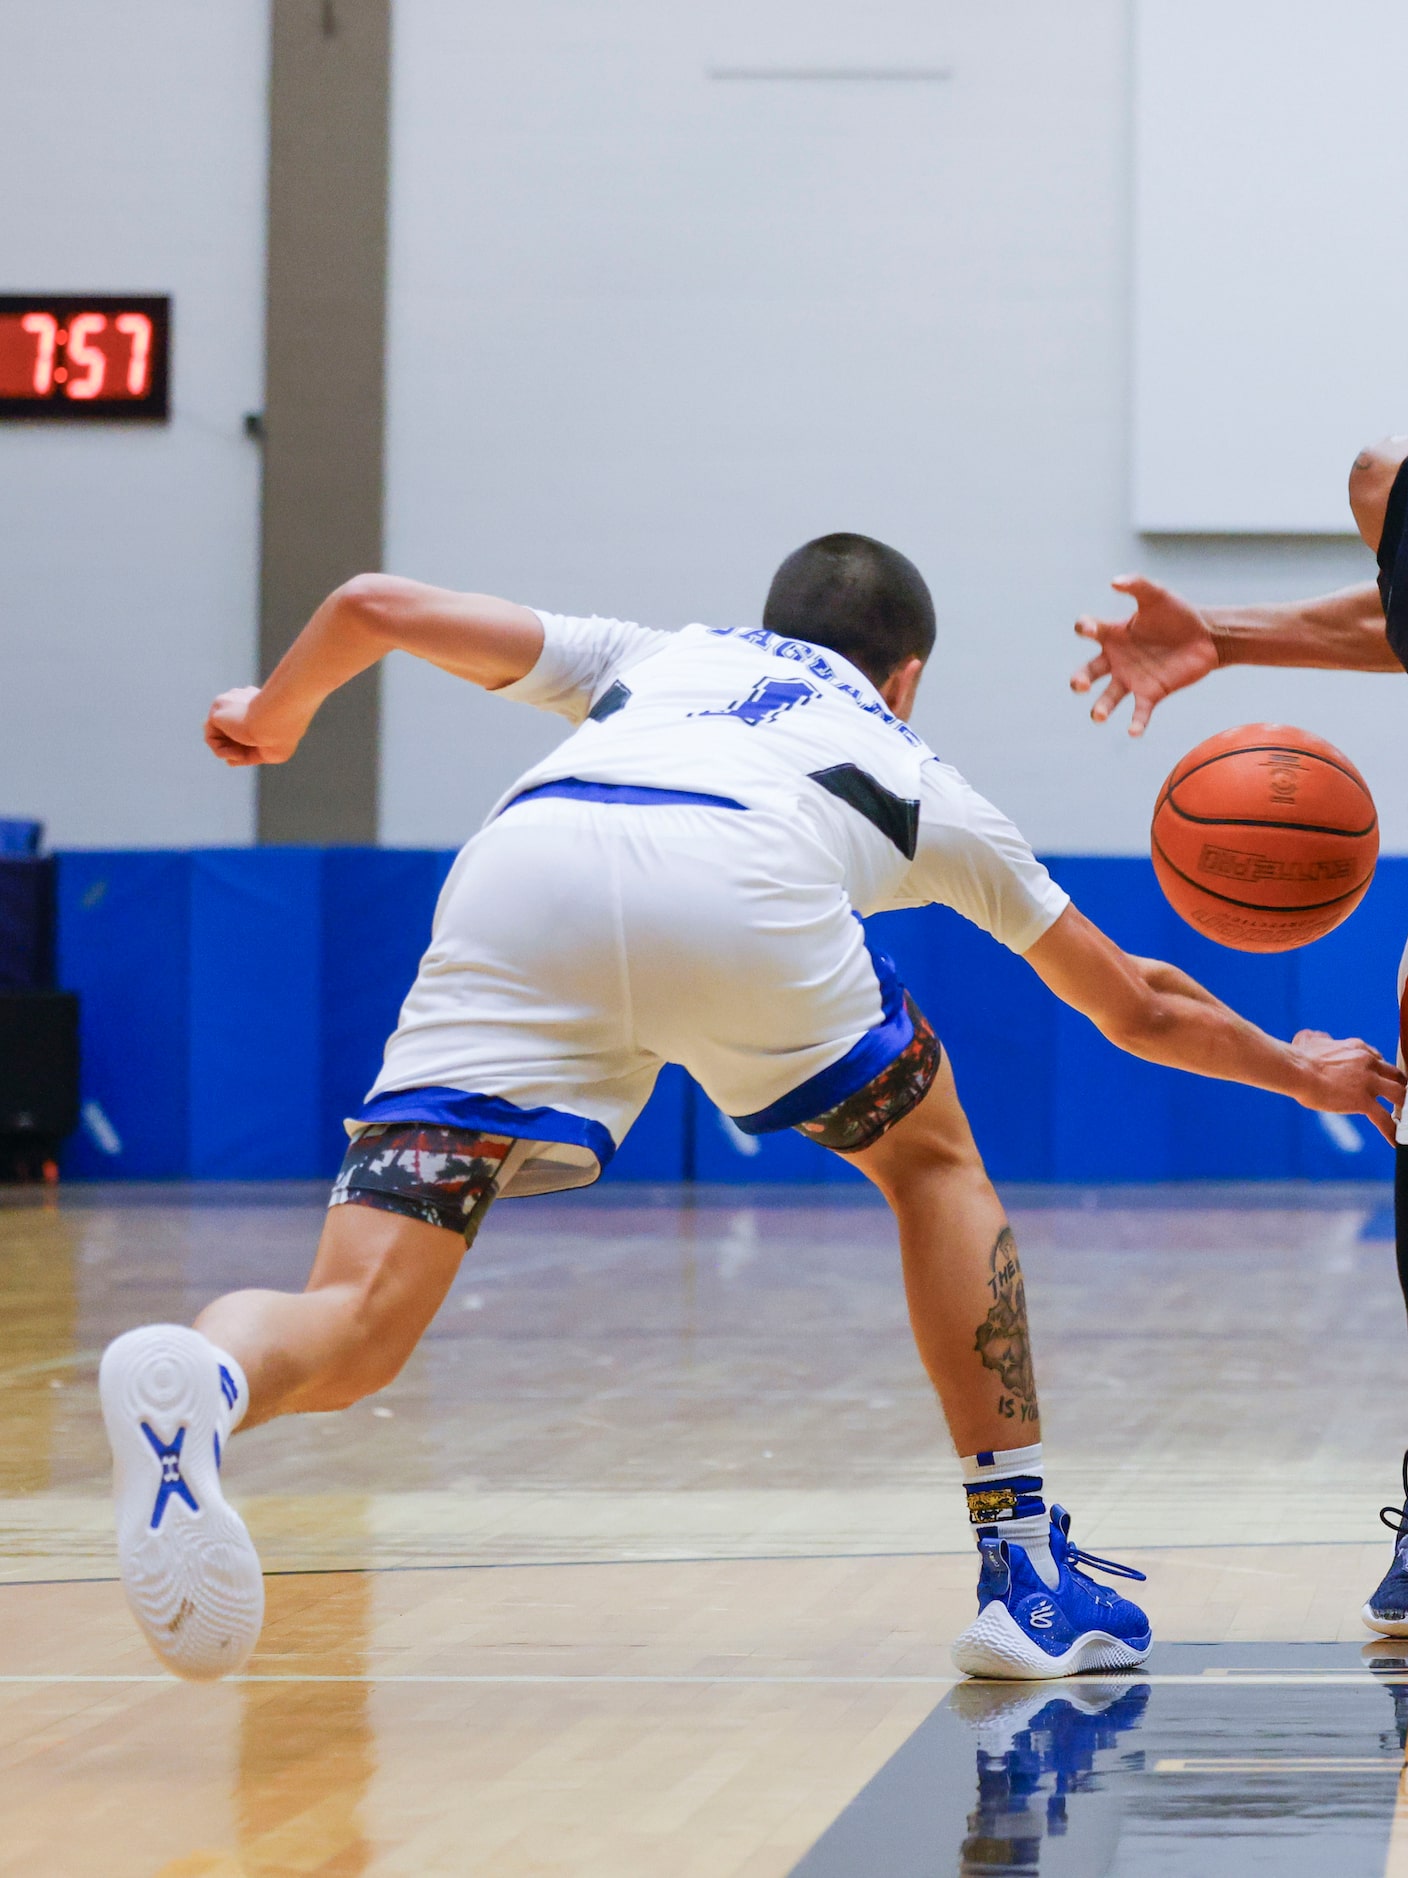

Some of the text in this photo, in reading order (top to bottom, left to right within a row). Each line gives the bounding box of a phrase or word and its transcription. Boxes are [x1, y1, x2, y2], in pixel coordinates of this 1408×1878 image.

[21, 312, 152, 399] 7:57
[987, 1260, 1016, 1300] THE
[998, 1395, 1015, 1418] IS
